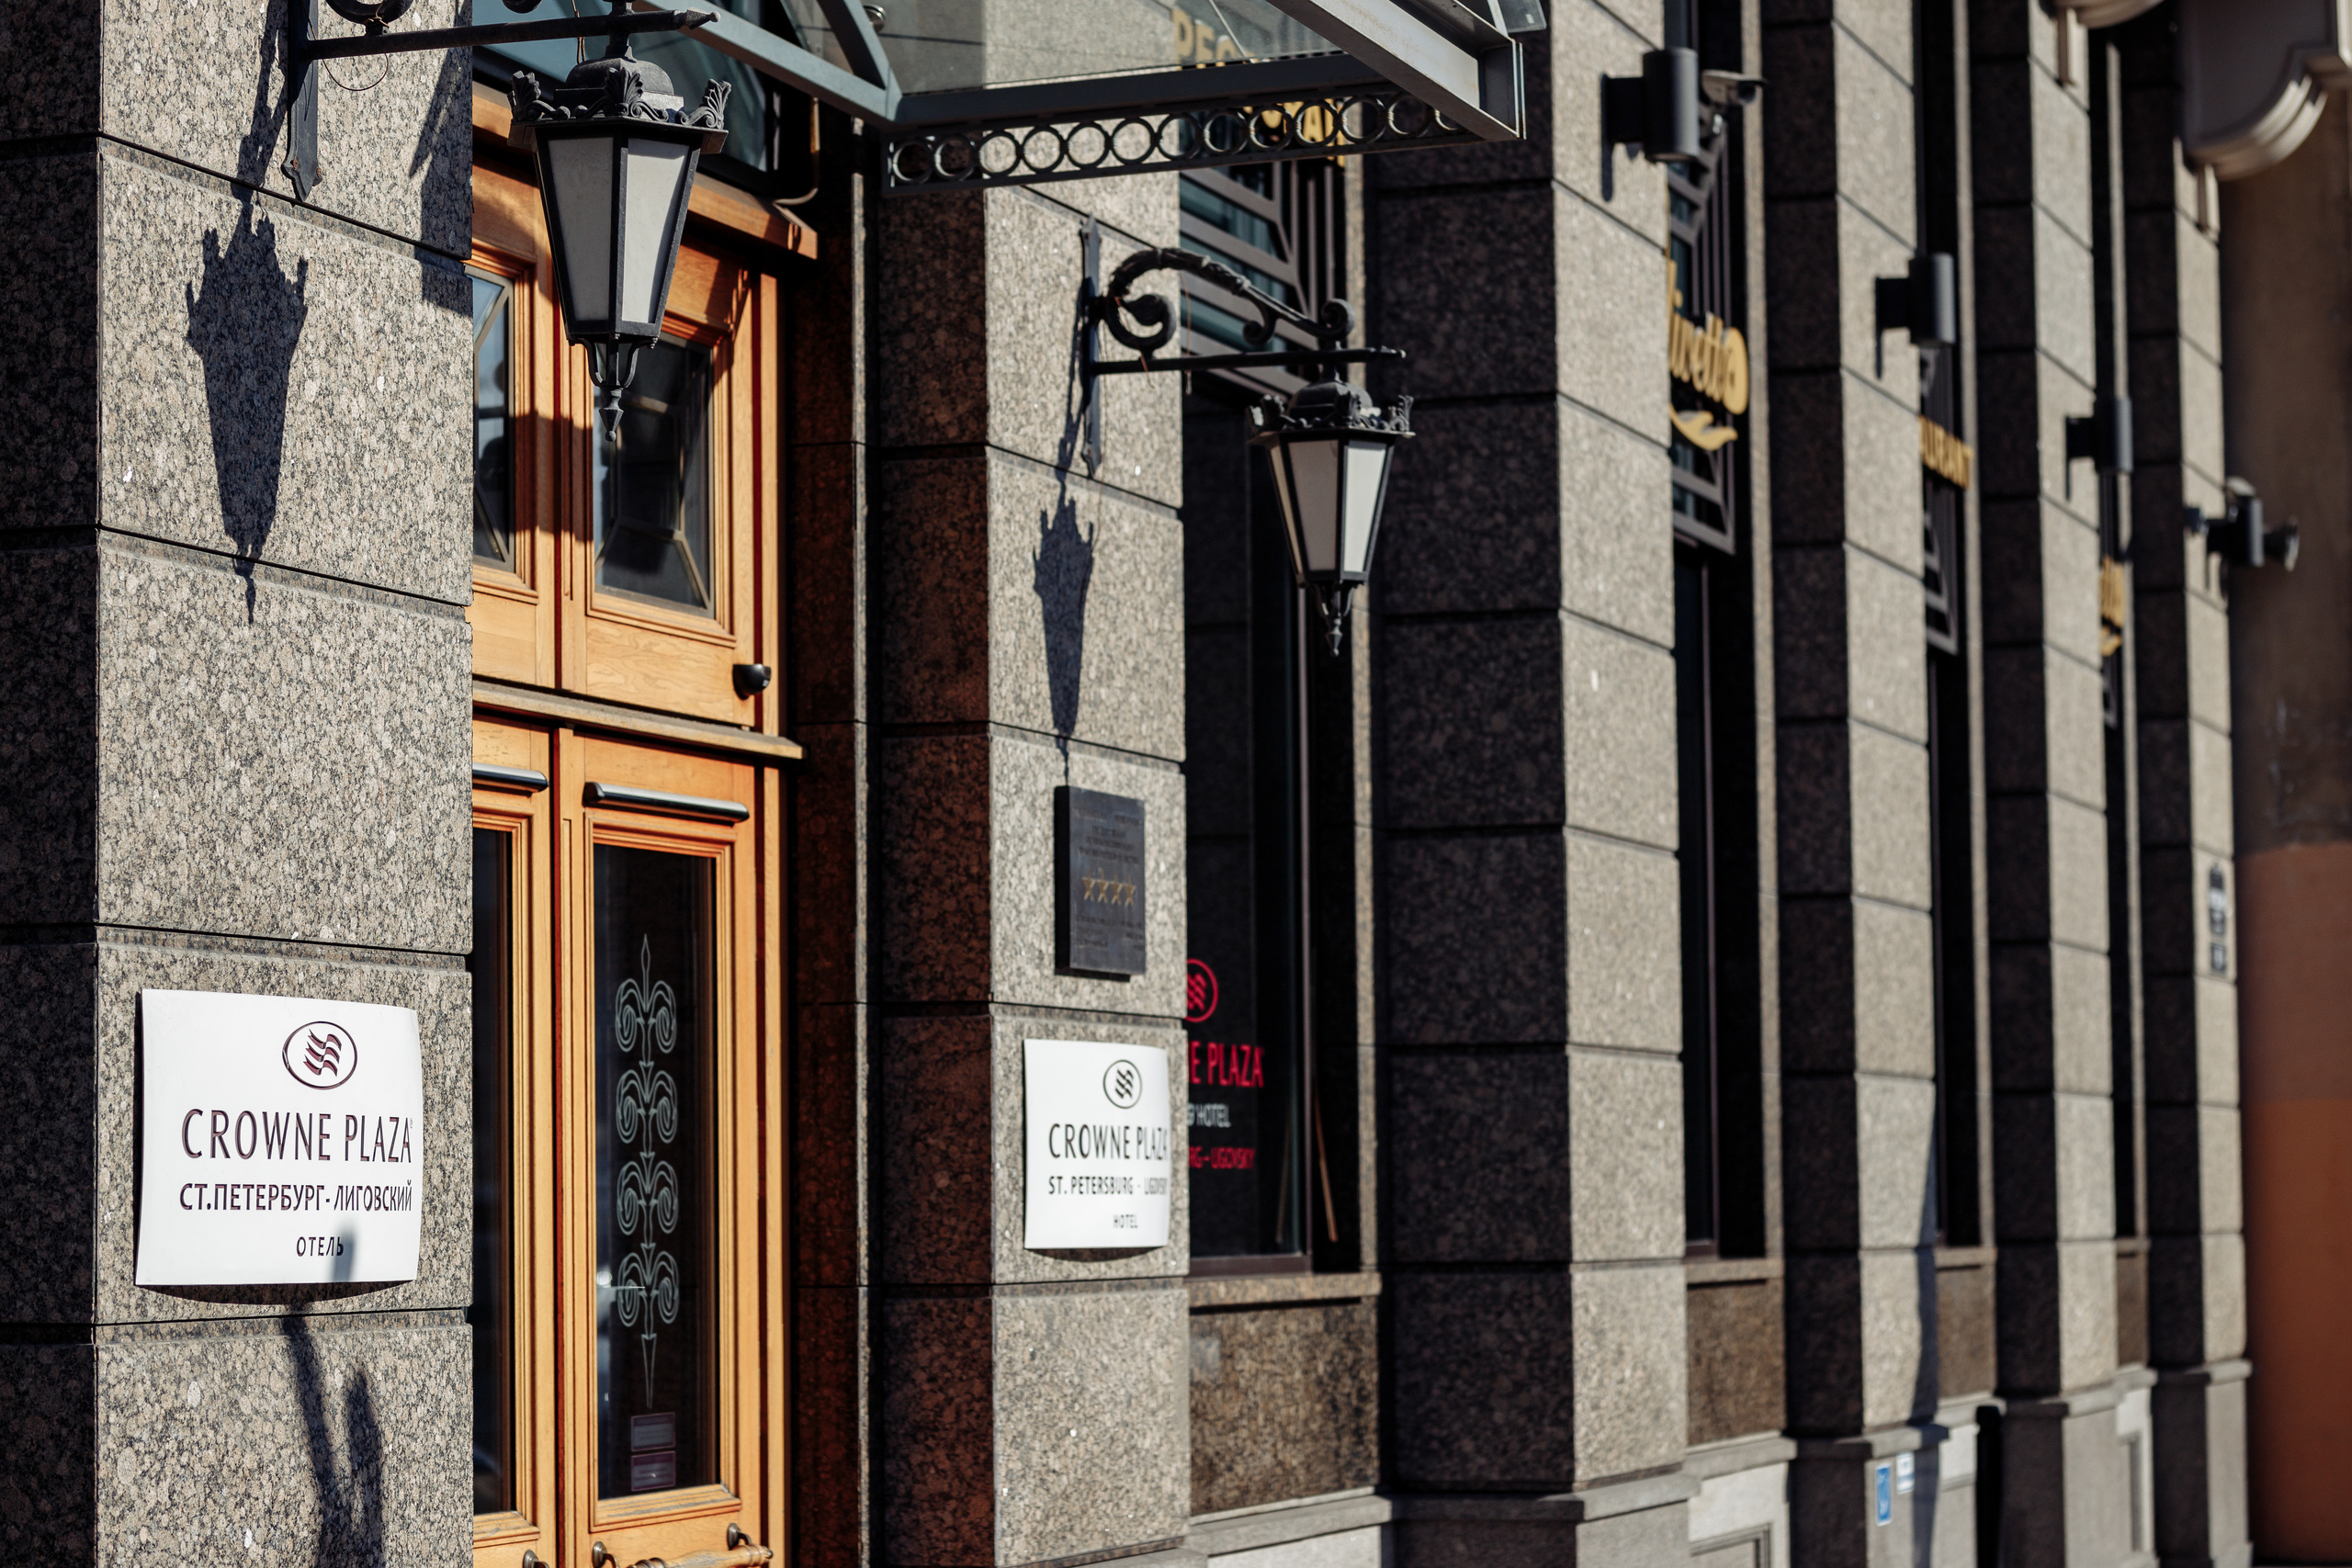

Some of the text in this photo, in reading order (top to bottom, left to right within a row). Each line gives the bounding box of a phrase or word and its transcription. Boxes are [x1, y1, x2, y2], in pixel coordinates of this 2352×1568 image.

[1207, 1042, 1265, 1088] PLAZA
[181, 1108, 412, 1163] CROWNE PLAZA
[1048, 1123, 1130, 1159] CROWNE
[1048, 1176, 1068, 1194] ST.
[1071, 1176, 1134, 1194] PETERSBURG
[1113, 1214, 1138, 1229] HOTEL
[296, 1235, 345, 1258] ОТЕЛЬ
